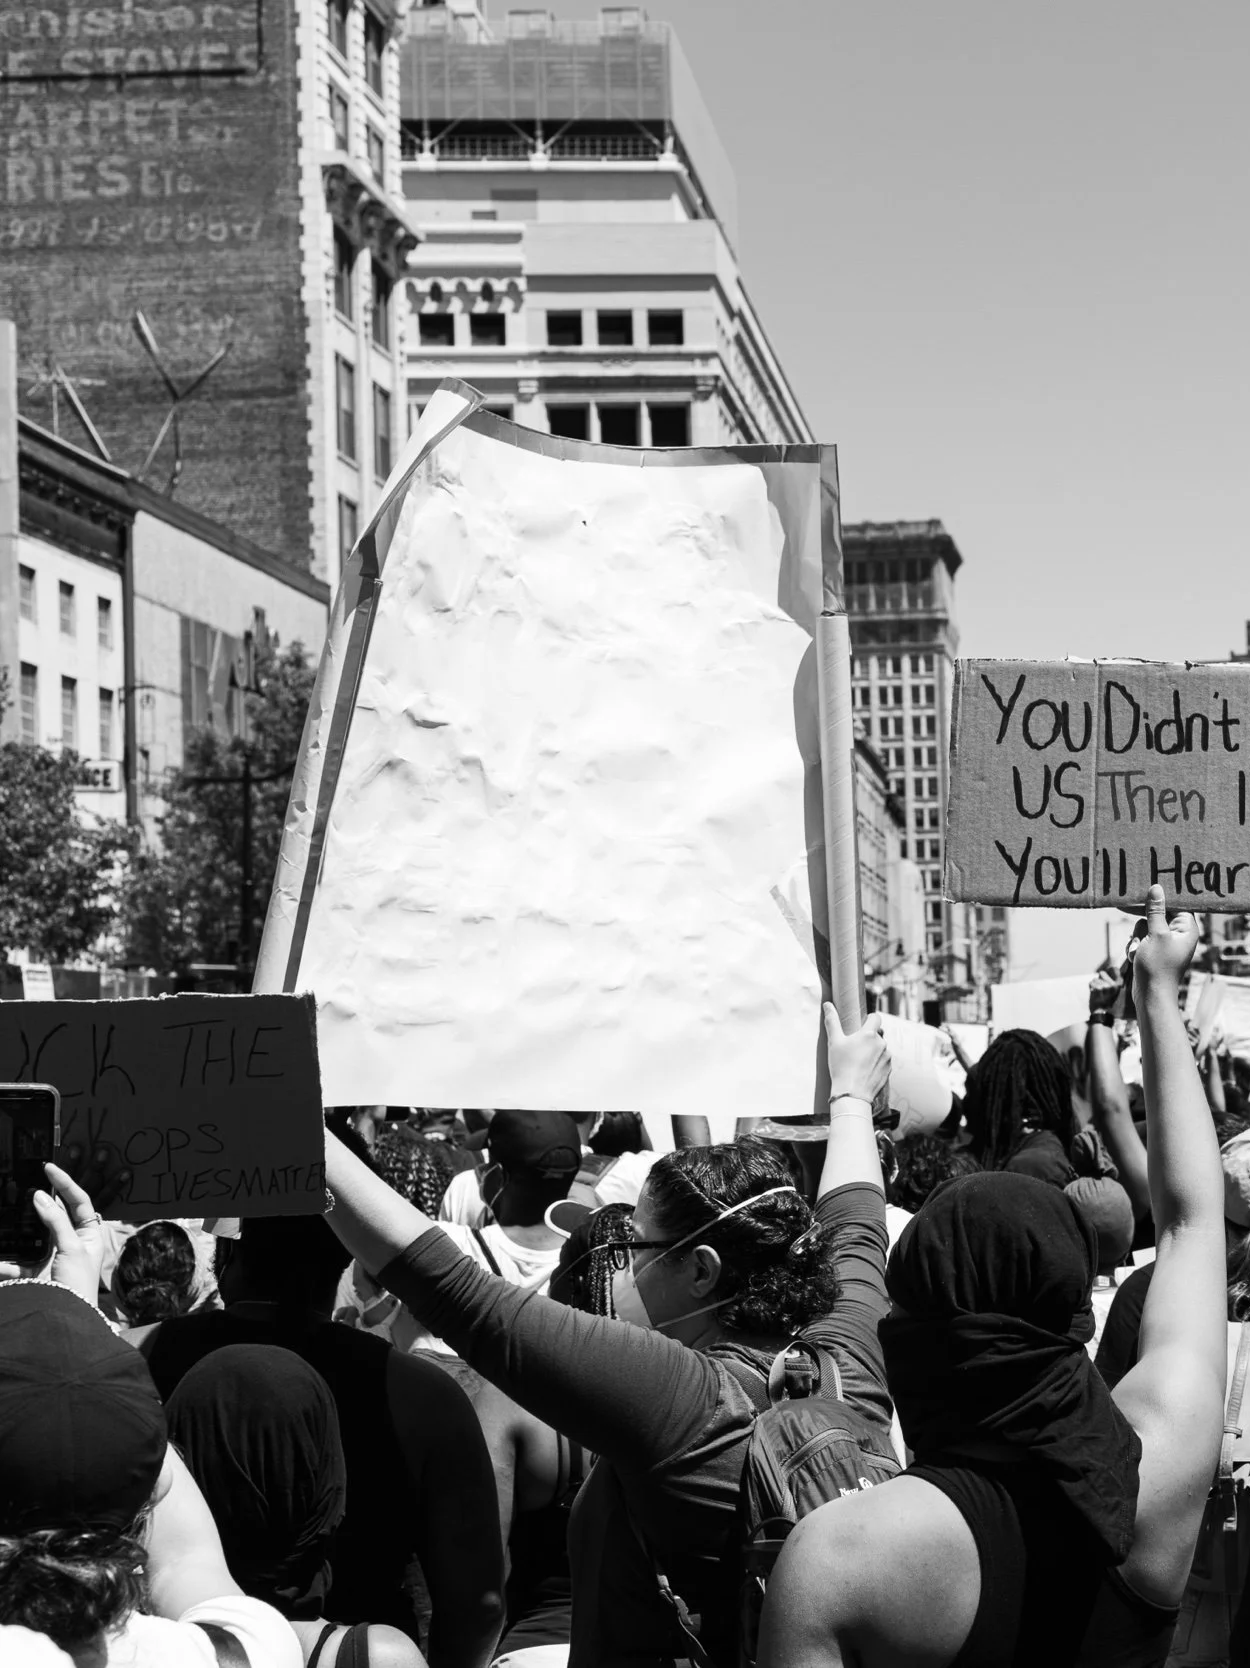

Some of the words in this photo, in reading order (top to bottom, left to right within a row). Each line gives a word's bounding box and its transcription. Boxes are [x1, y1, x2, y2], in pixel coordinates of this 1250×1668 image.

[1104, 680, 1240, 754] Didn't
[1098, 770, 1206, 824] Then
[1238, 771, 1246, 825] I
[1150, 845, 1250, 898] Hear
[163, 1020, 285, 1088] THE
